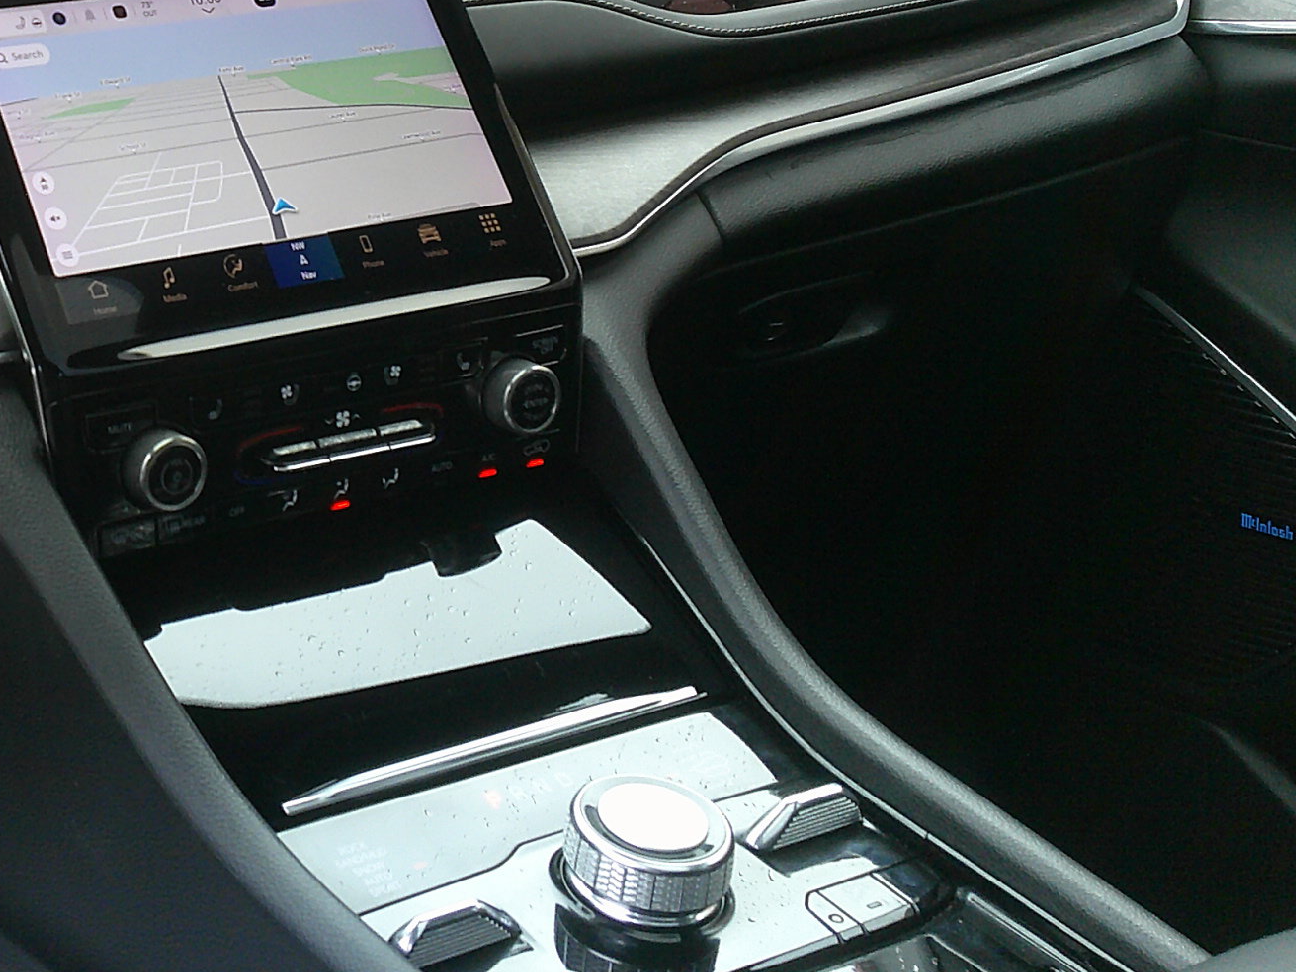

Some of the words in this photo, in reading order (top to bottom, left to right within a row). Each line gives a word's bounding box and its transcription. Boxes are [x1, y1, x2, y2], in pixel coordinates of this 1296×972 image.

[11, 49, 44, 61] Search
[362, 260, 385, 269] Phone
[300, 270, 317, 281] Nav
[227, 280, 258, 292] Comfort
[162, 293, 188, 303] Media
[93, 305, 118, 315] Home
[1241, 513, 1294, 541] McIntosh
